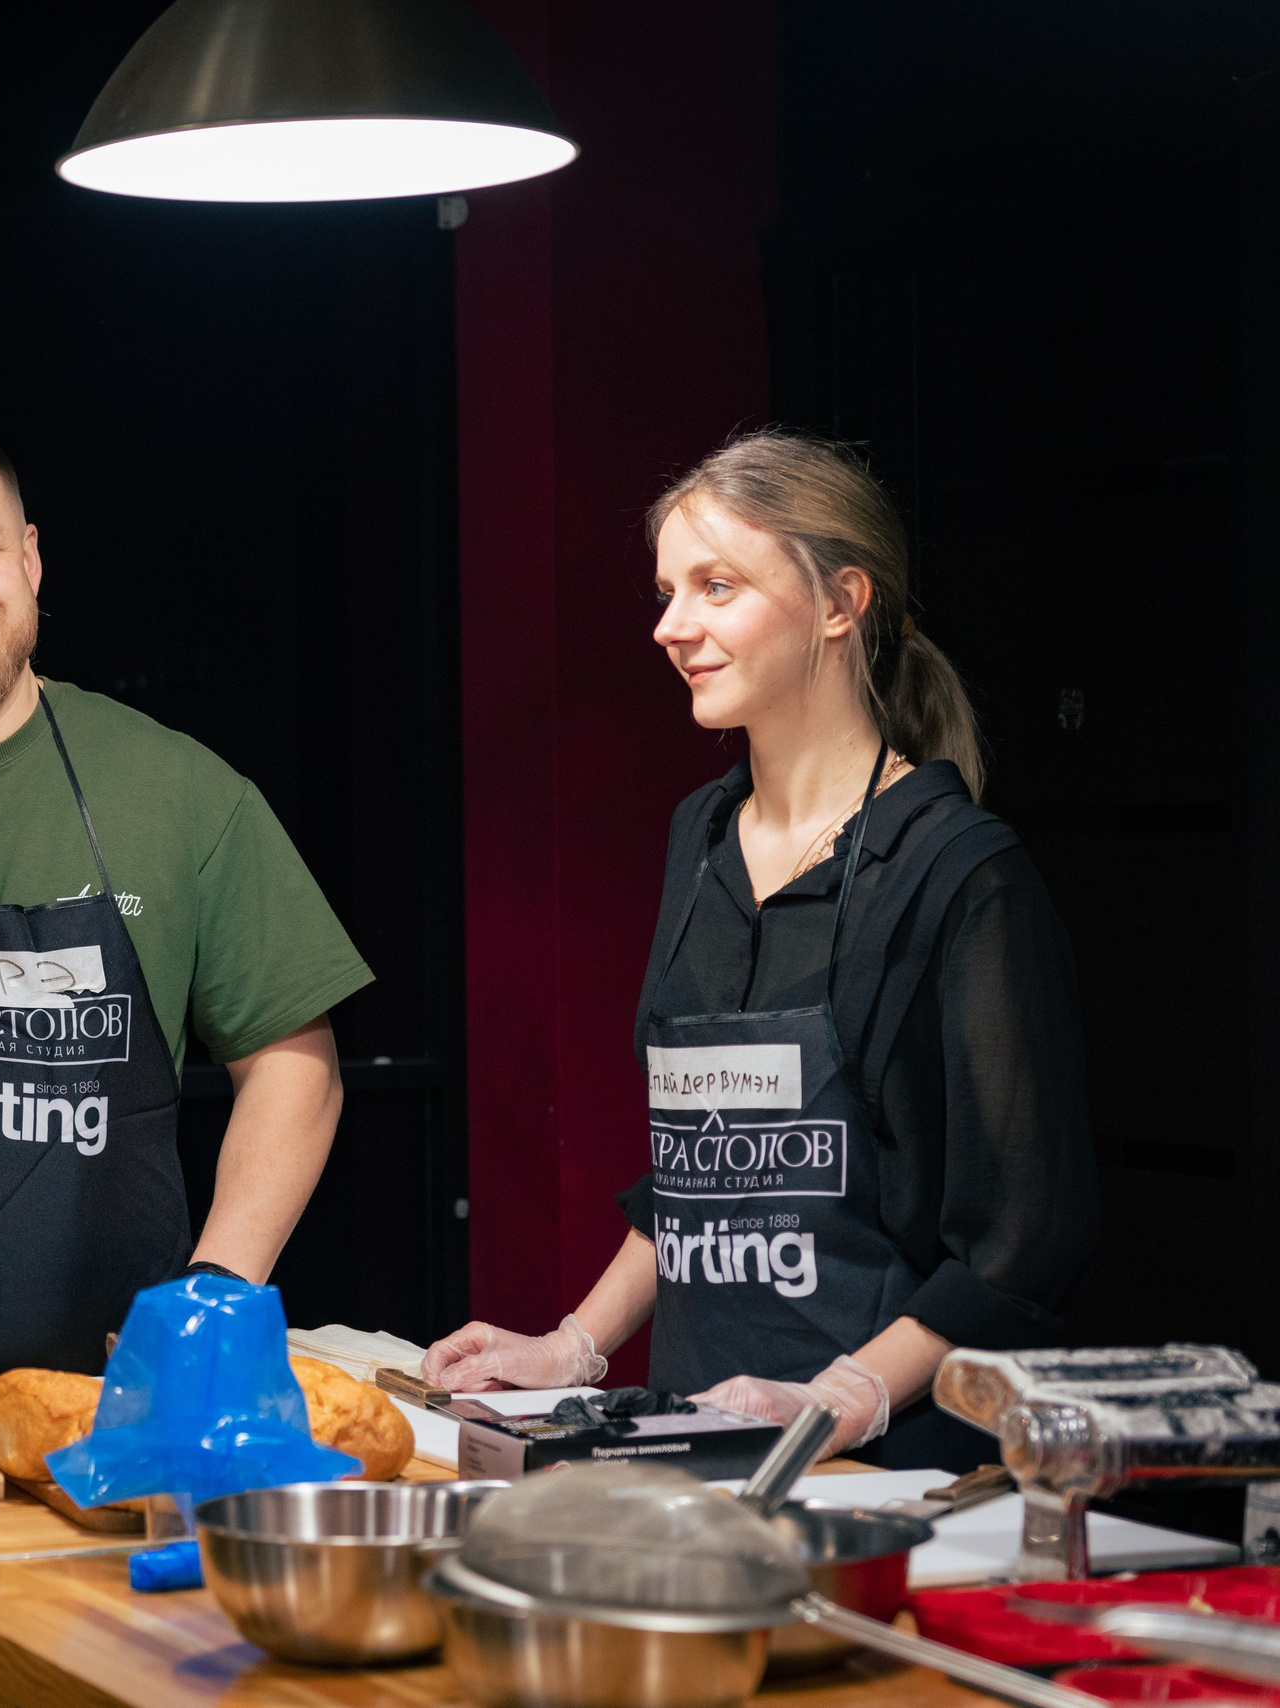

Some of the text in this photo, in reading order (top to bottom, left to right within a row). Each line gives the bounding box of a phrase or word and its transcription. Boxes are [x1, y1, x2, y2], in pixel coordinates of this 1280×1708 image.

[26, 1043, 86, 1058] СТУДИЯ
[36, 1080, 100, 1095] since 1889
[651, 1130, 835, 1172] ГРА СТОЛОВ
[724, 1173, 785, 1189] СТУДИЯ
[729, 1214, 800, 1230] since 1889
[654, 1212, 818, 1298] körting
